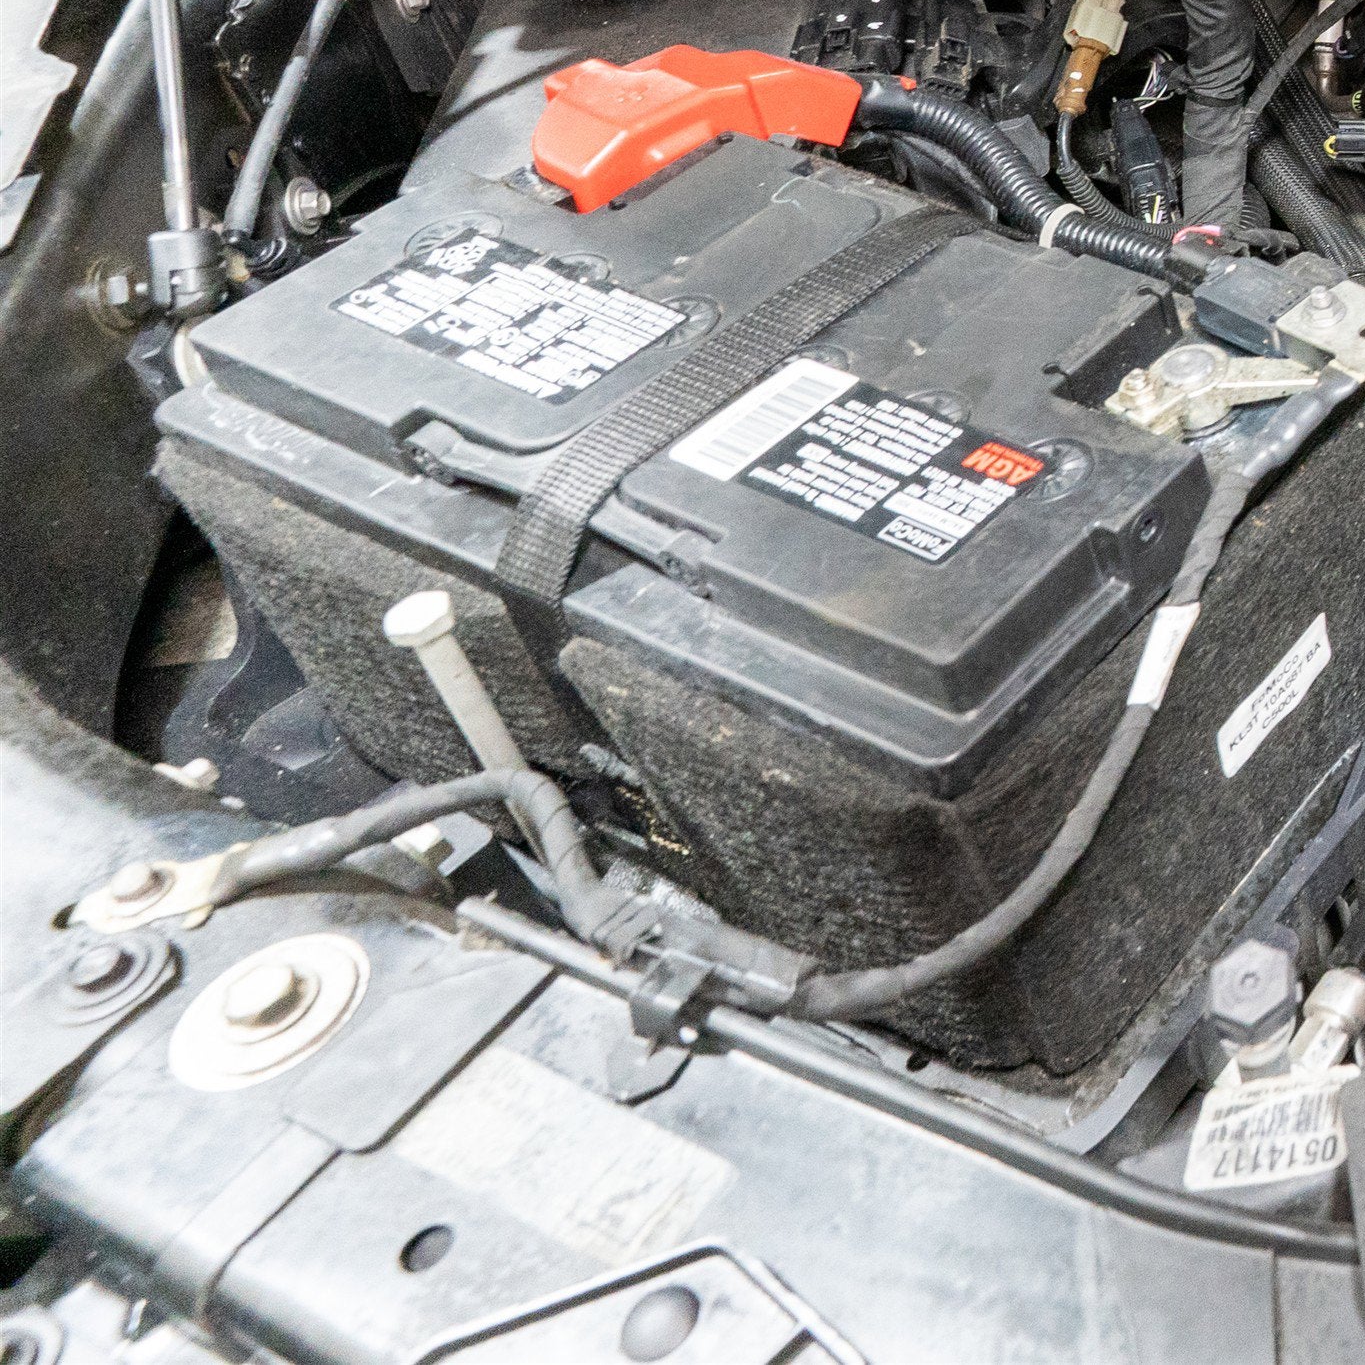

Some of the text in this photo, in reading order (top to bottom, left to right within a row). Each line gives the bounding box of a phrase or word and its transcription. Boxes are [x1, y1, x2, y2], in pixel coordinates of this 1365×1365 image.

[961, 450, 1034, 485] AGM
[889, 521, 950, 555] FoMoCo
[1229, 711, 1260, 752] KL3T
[1306, 642, 1321, 663] BA
[1250, 654, 1299, 712] FoMoCo
[1262, 689, 1299, 730] C500L
[1212, 1134, 1338, 1178] 0514117
